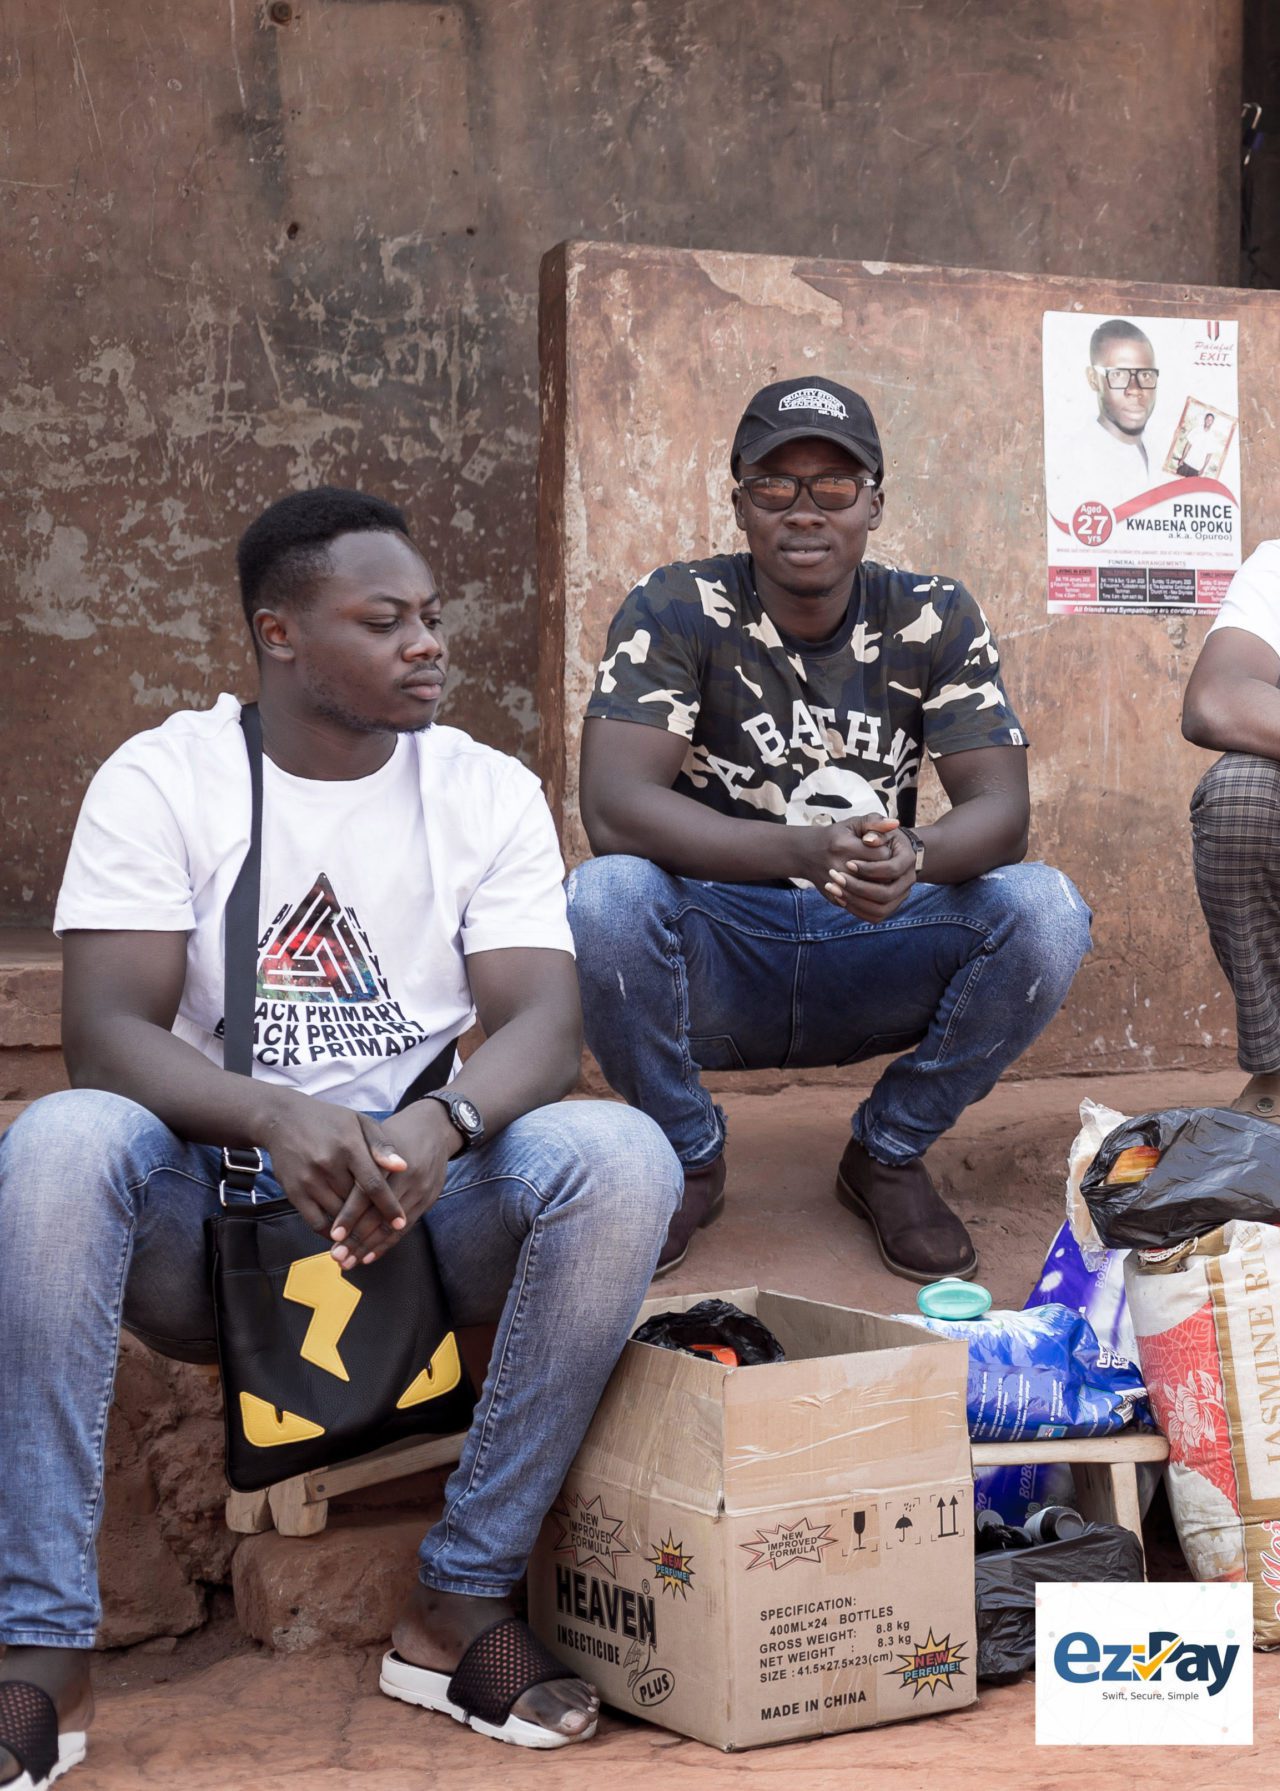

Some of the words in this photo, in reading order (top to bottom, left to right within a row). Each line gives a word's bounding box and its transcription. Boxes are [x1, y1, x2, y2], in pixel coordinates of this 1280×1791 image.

[1199, 352, 1229, 362] EXIT
[1080, 504, 1102, 514] Aged
[1173, 503, 1232, 519] PRINCE
[1077, 515, 1109, 535] 27
[1126, 518, 1187, 532] KWABENA
[1190, 520, 1232, 534] OPOKU
[1087, 535, 1102, 544] yrs
[254, 1002, 299, 1022] ACK
[306, 1001, 407, 1023] PRIMARY
[306, 1020, 426, 1045] PRIMARY
[580, 1511, 599, 1528] NEW
[569, 1521, 612, 1545] IMPROVED
[781, 1531, 803, 1541] NEW
[571, 1534, 611, 1558] FORMULA
[767, 1537, 818, 1551] IMPROVED
[769, 1545, 816, 1559] FORMULA
[661, 1552, 683, 1569] NEW
[655, 1564, 690, 1582] PERFUME!
[555, 1563, 658, 1649] HEAVEN
[760, 1596, 857, 1622] SPECIFICATION:
[839, 1605, 894, 1625] BOTTLES
[557, 1624, 620, 1666] INSECTICIDE
[759, 1638, 802, 1654] GROSS
[806, 1628, 857, 1646] WEIGHT:
[876, 1622, 893, 1634] 8.8
[897, 1620, 910, 1632] kg
[759, 1656, 784, 1669] NET
[788, 1646, 836, 1664] WEIGHT
[877, 1636, 894, 1648] 8.3
[898, 1634, 912, 1646] kg
[914, 1650, 949, 1668] NEW
[759, 1669, 787, 1684] SIZE
[903, 1662, 959, 1681] PERFUME!
[639, 1673, 670, 1703] PLUS
[761, 1702, 800, 1721] MADE
[805, 1698, 819, 1712] IN
[824, 1690, 867, 1709] CHINA
